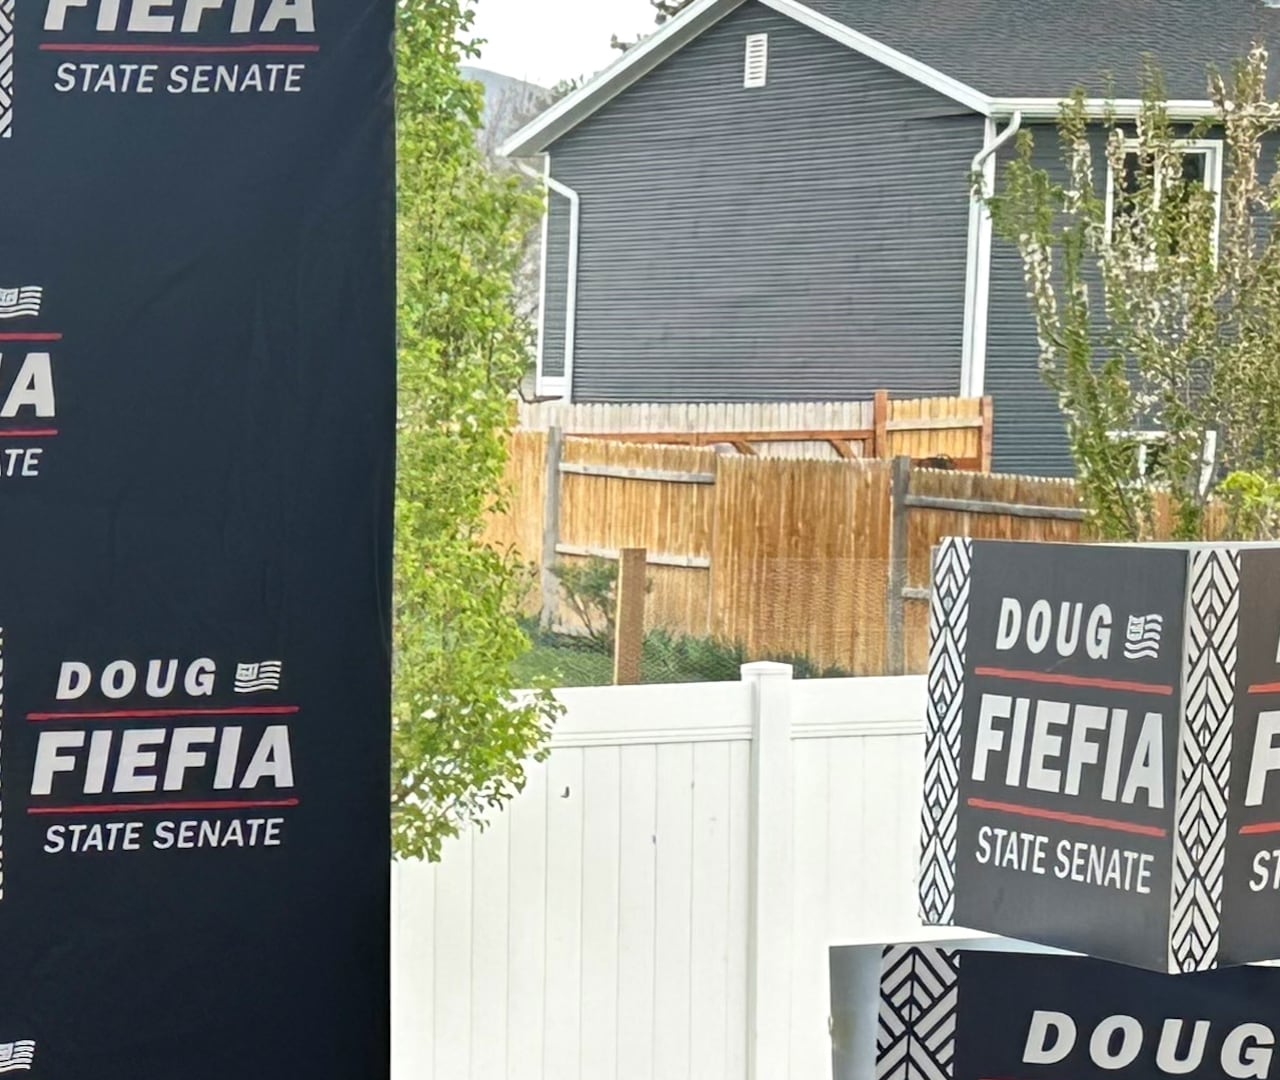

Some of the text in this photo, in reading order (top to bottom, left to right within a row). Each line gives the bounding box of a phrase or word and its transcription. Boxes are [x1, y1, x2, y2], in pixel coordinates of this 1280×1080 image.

[54, 62, 305, 94] STATE SENATE
[995, 597, 1113, 660] DOUG
[55, 657, 216, 700] DOUG
[30, 725, 294, 795] FIEFIA
[971, 693, 1165, 809] FIEFIA
[43, 817, 284, 854] STATE SENATE
[975, 826, 1155, 894] STATE SENATE
[1022, 1010, 1275, 1080] DOUG
